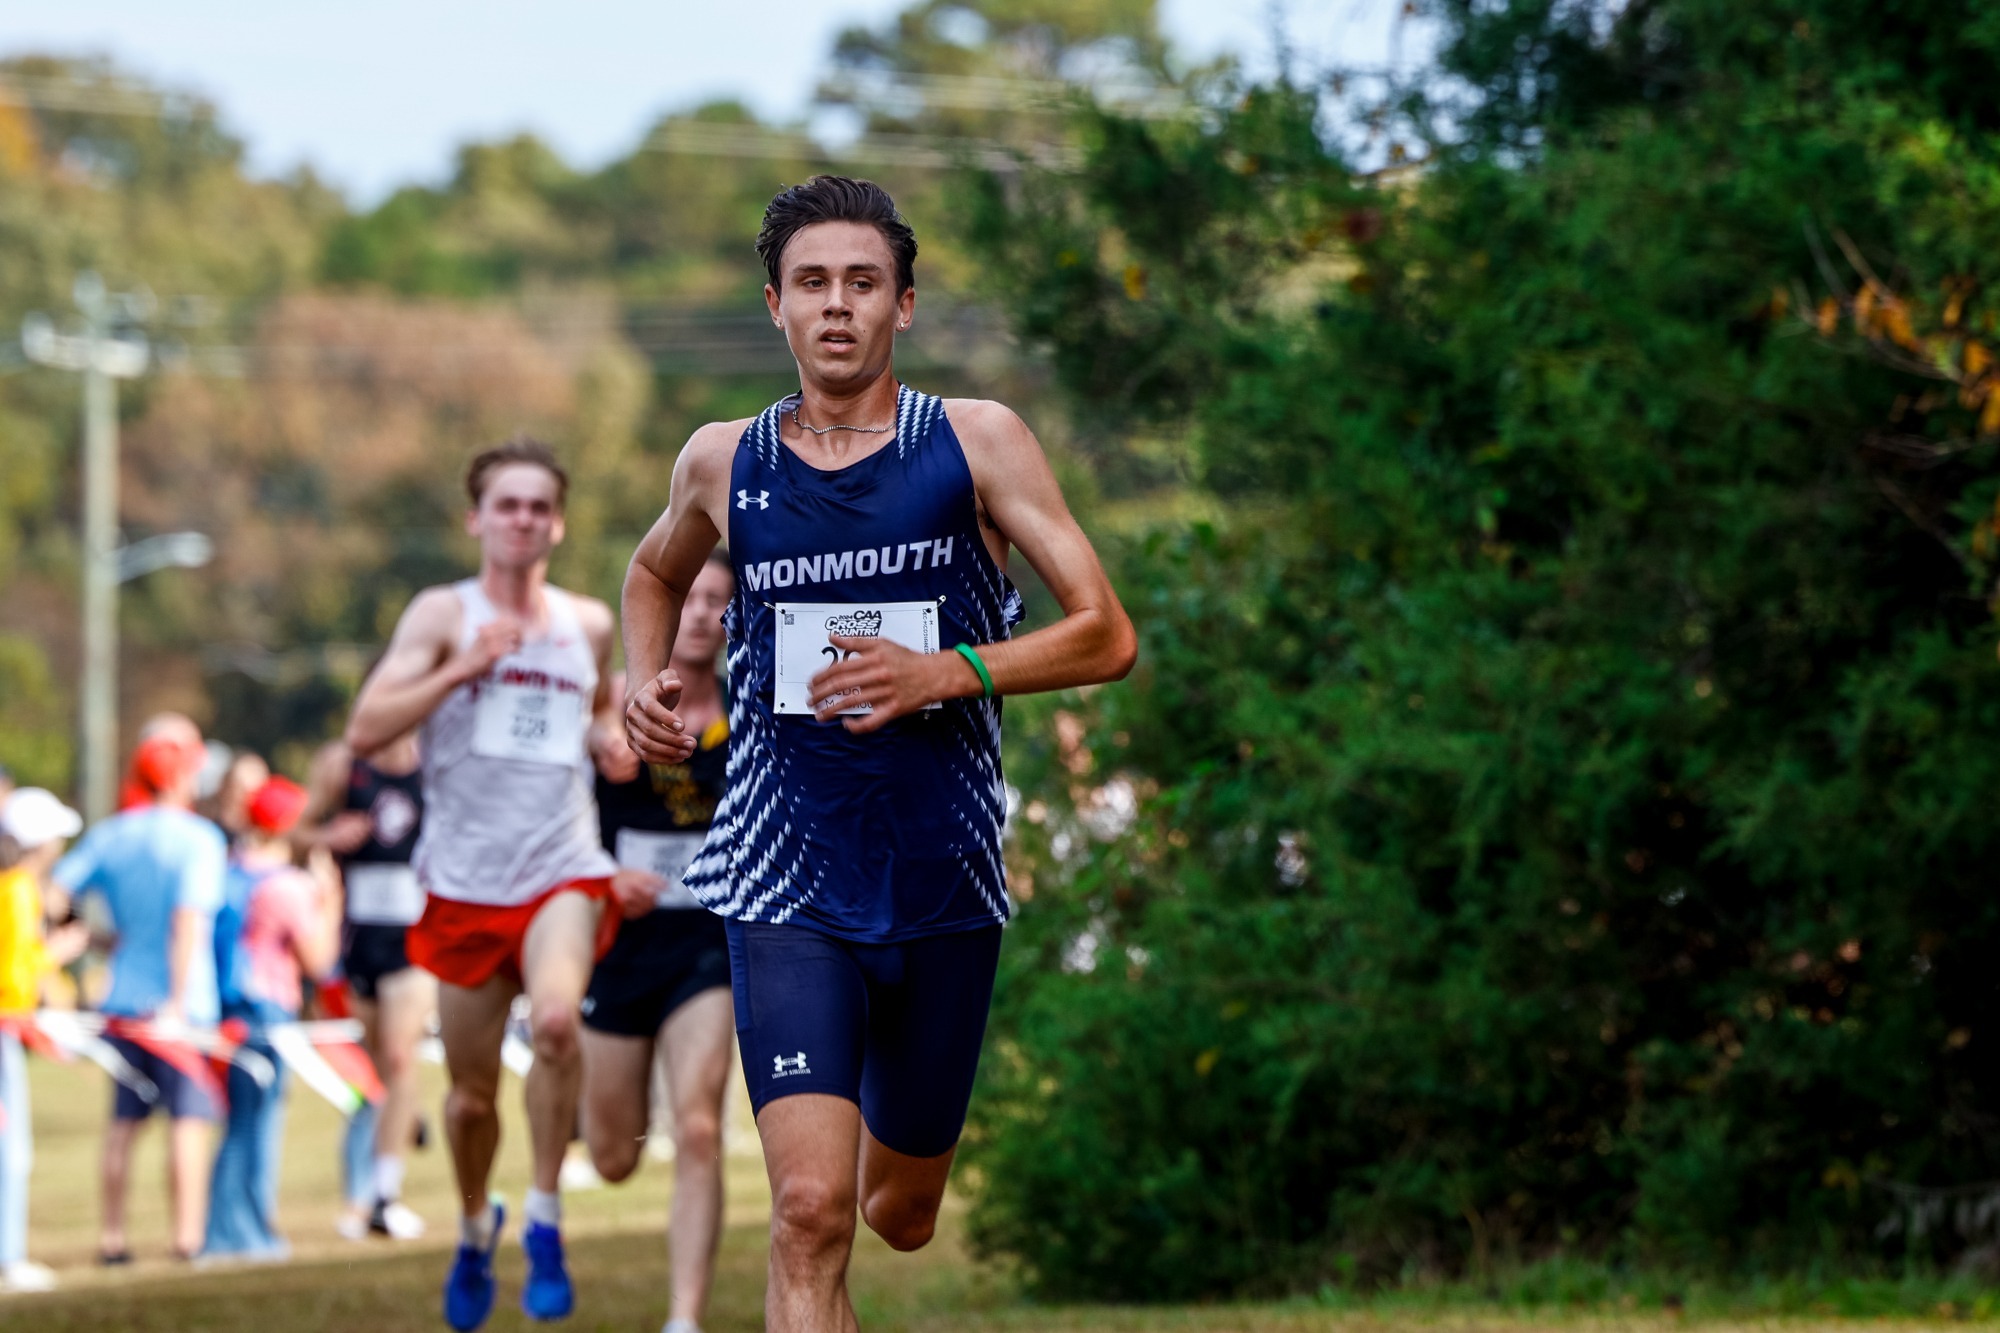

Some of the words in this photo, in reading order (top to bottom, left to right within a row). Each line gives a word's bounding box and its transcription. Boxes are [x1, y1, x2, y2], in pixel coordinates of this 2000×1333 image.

[745, 536, 954, 592] MONMOUTH
[853, 610, 882, 620] CAA
[825, 616, 879, 630] CROSS
